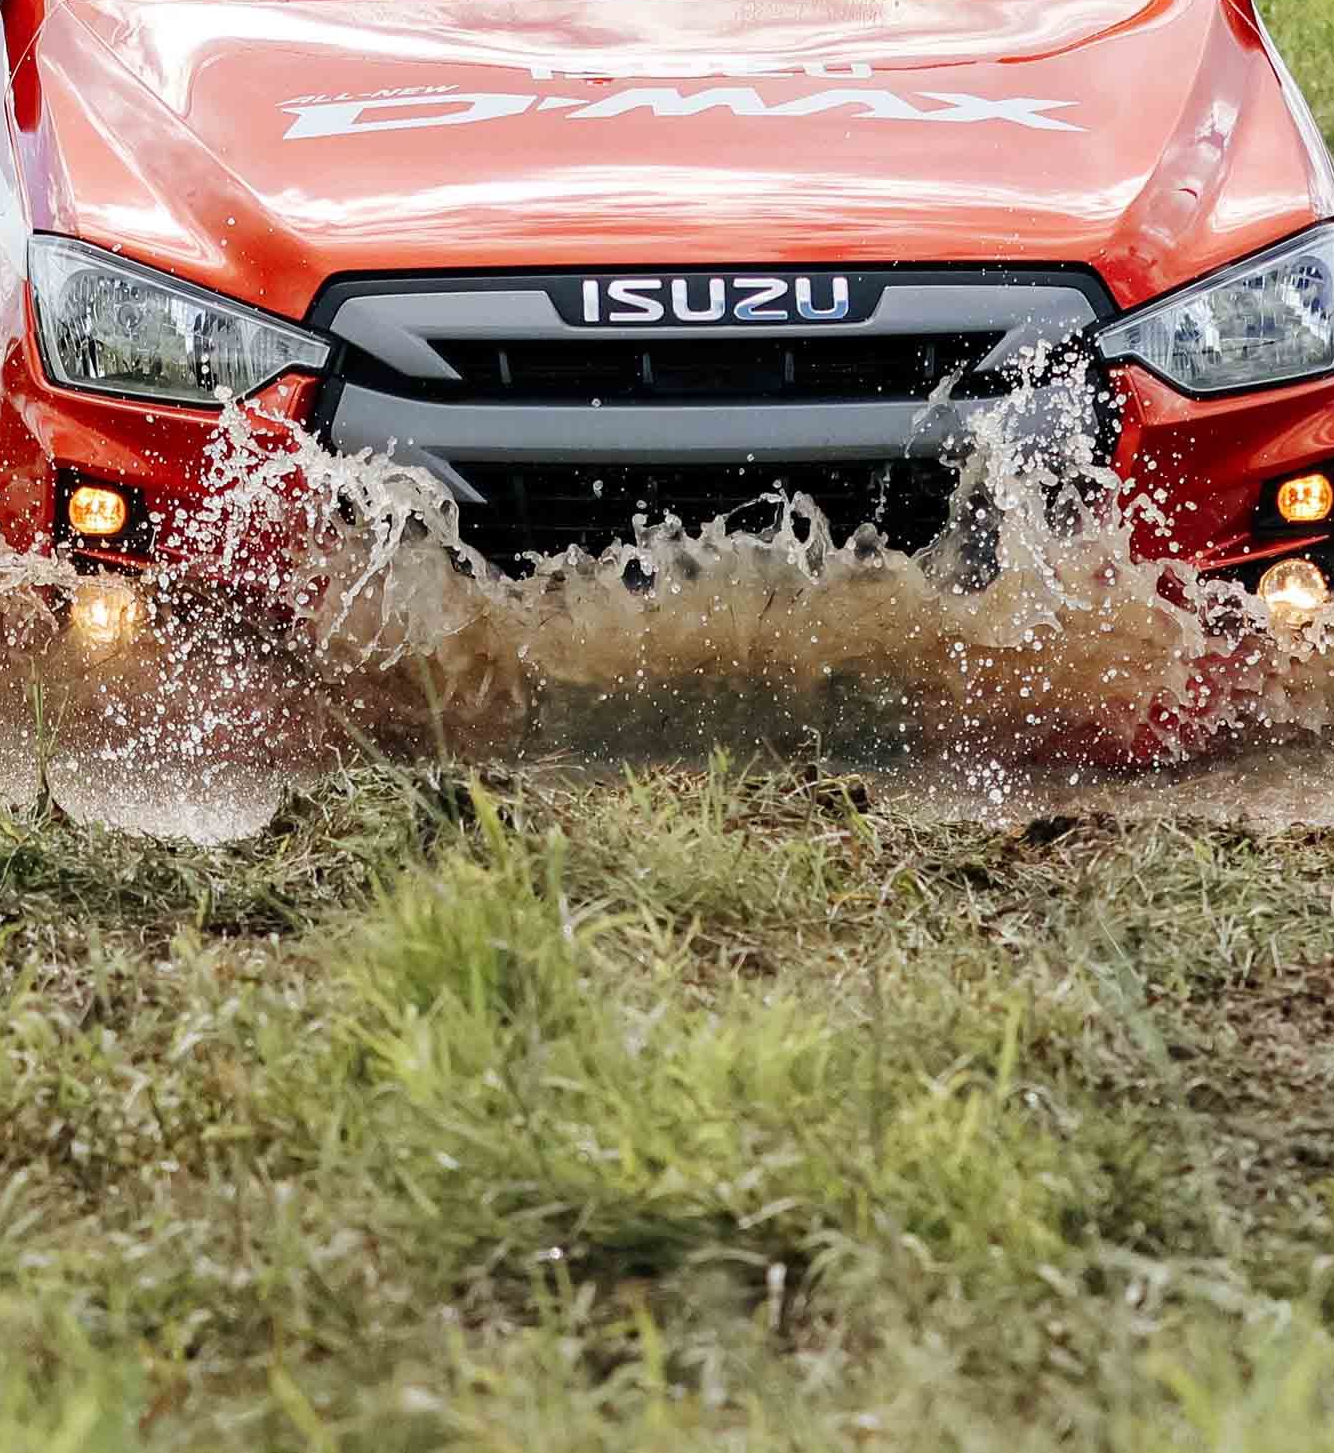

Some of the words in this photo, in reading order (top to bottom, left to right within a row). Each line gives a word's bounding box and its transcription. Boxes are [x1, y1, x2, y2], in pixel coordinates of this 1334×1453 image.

[275, 84, 460, 108] ALL-NEW
[282, 86, 1092, 140] D-MAX
[581, 276, 851, 323] ISUZU
